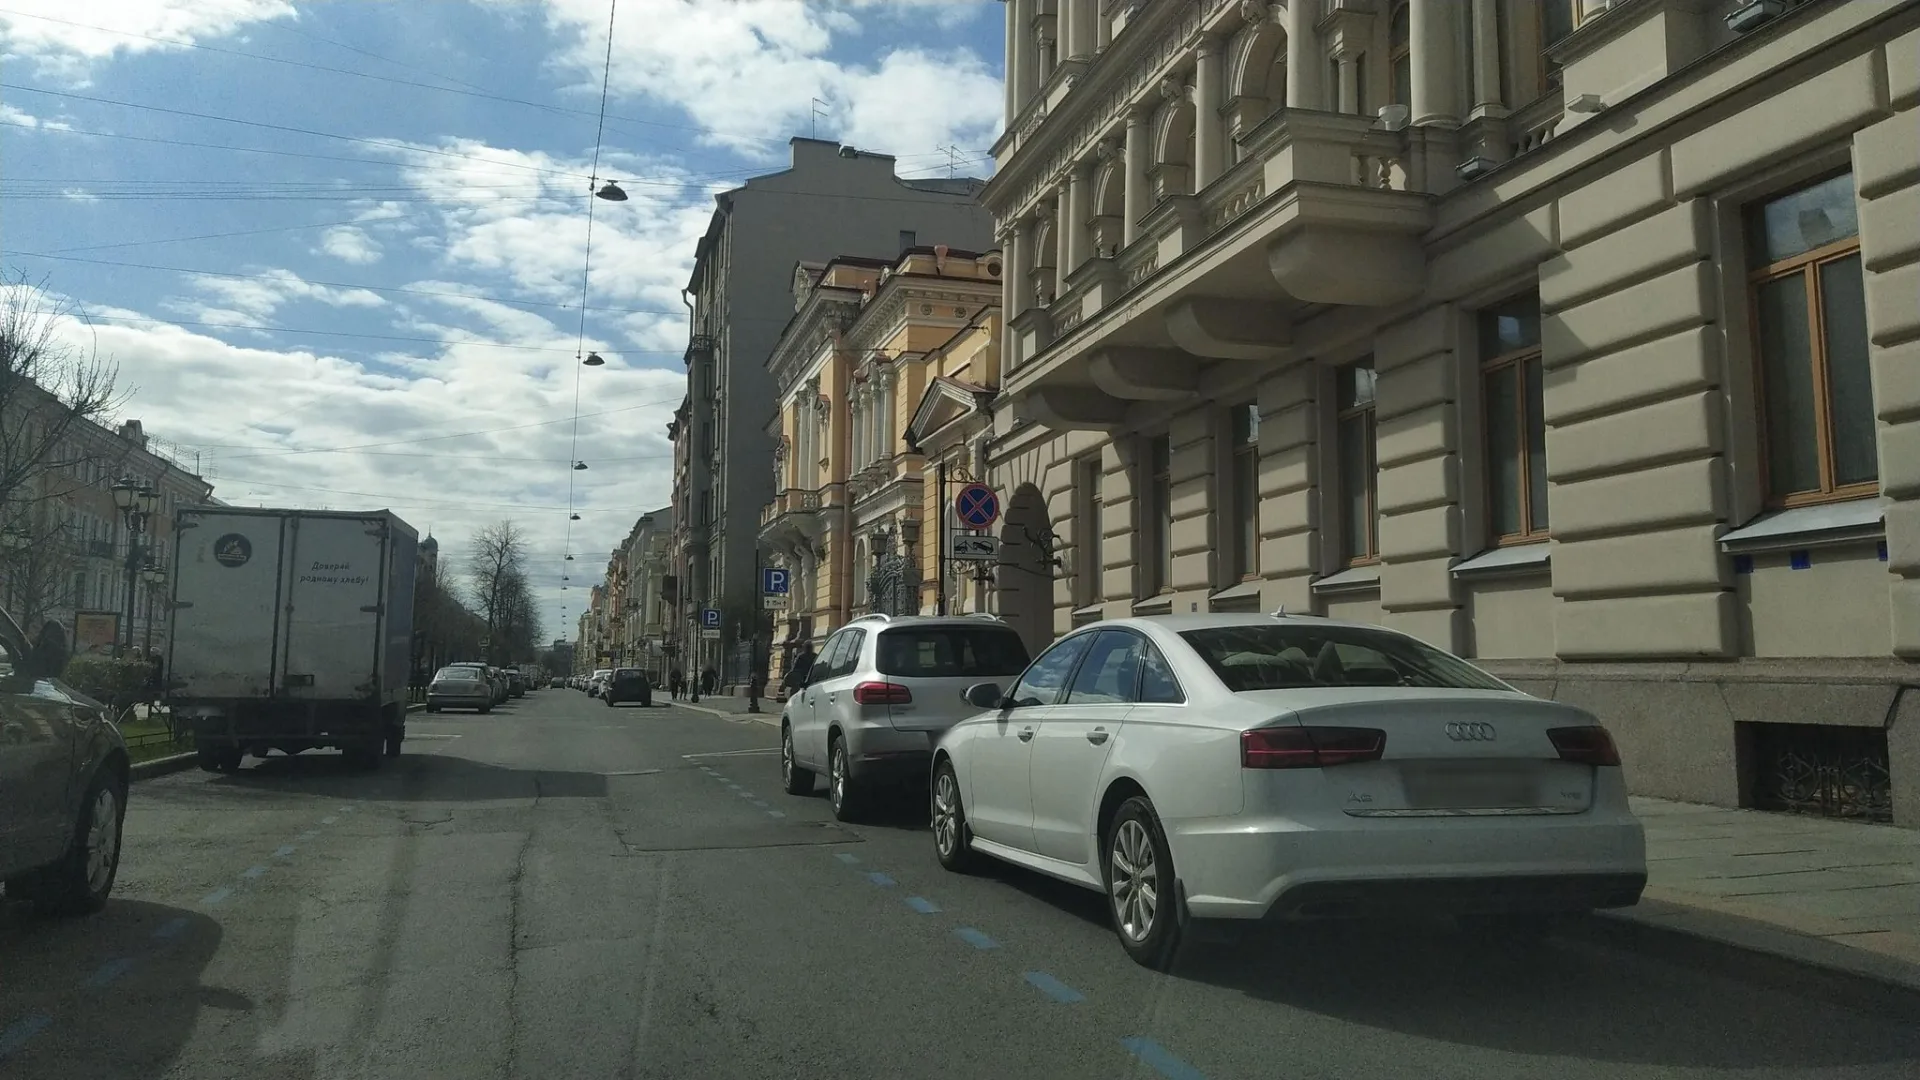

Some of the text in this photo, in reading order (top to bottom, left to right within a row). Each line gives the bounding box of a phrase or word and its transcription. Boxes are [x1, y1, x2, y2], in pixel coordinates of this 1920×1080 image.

[300, 575, 338, 584] родному
[771, 571, 785, 591] P
[707, 611, 718, 625] P
